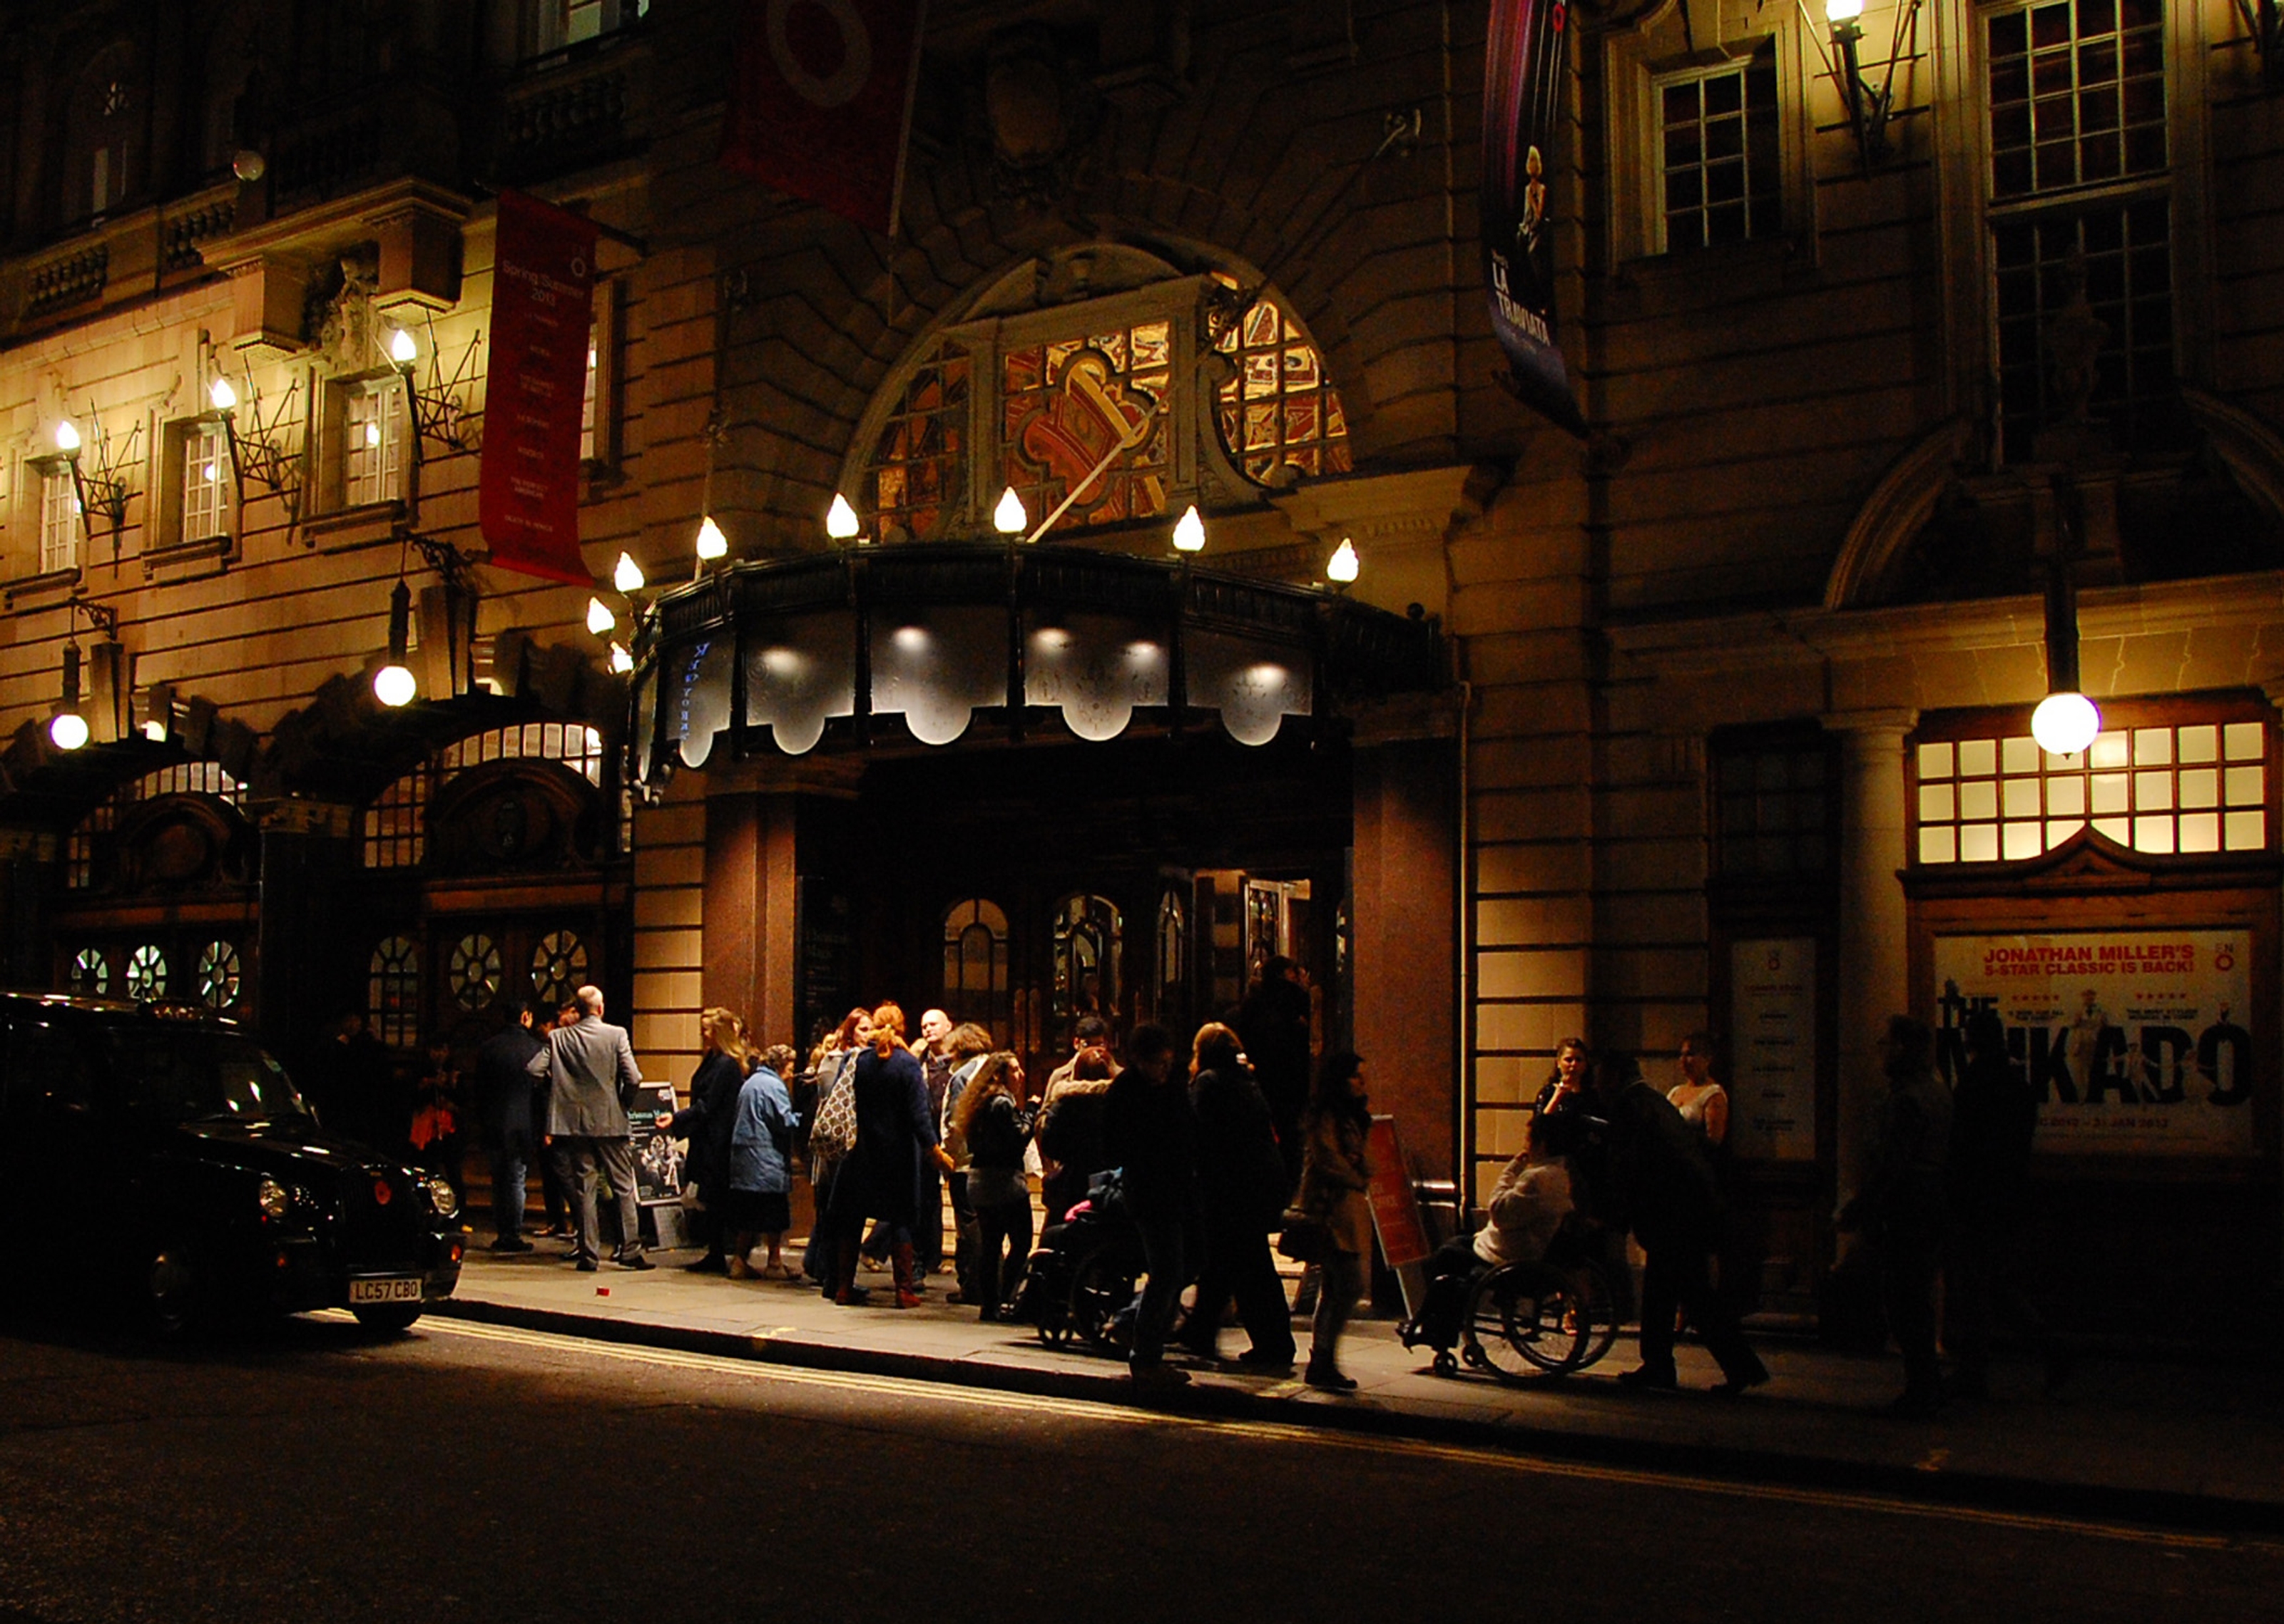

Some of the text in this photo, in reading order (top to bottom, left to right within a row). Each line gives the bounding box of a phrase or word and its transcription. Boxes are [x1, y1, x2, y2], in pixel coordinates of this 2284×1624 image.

[1492, 261, 1510, 295] LA
[531, 287, 556, 307] 2013
[1495, 289, 1551, 347] TRAVIATA
[1984, 944, 2195, 964] JONATHAN MILLER'S
[1984, 961, 2195, 977] 5-STAR CLASSIC IS BACK!
[1937, 996, 1999, 1029] THE
[2111, 1118, 2135, 1128] JAN
[356, 1282, 392, 1299] LC57
